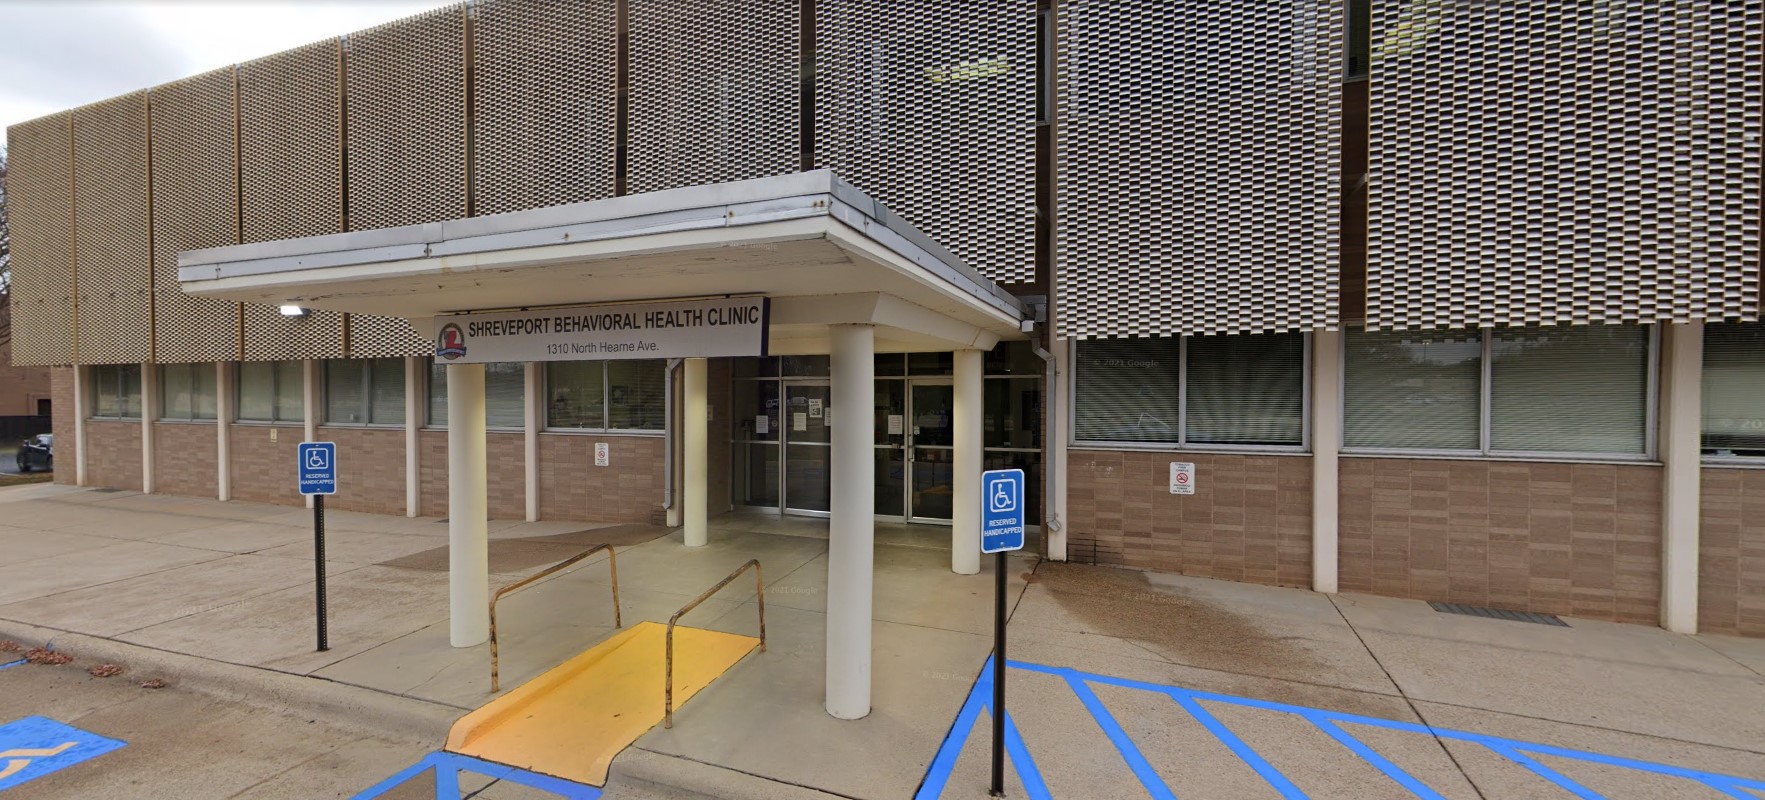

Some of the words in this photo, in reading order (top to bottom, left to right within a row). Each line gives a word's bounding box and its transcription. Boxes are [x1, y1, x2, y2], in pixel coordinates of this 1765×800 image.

[468, 317, 550, 338] SHREVEPORT
[554, 312, 641, 333] BEHAVIORAL
[645, 309, 703, 329] HEALTH
[707, 305, 760, 326] CLINIC
[547, 344, 569, 355] 1310
[571, 342, 597, 354] North
[599, 341, 635, 353] Hearne
[637, 340, 660, 351] Ave.
[988, 517, 1017, 527] RESERVED
[984, 526, 1022, 537] HANDICAPPED
